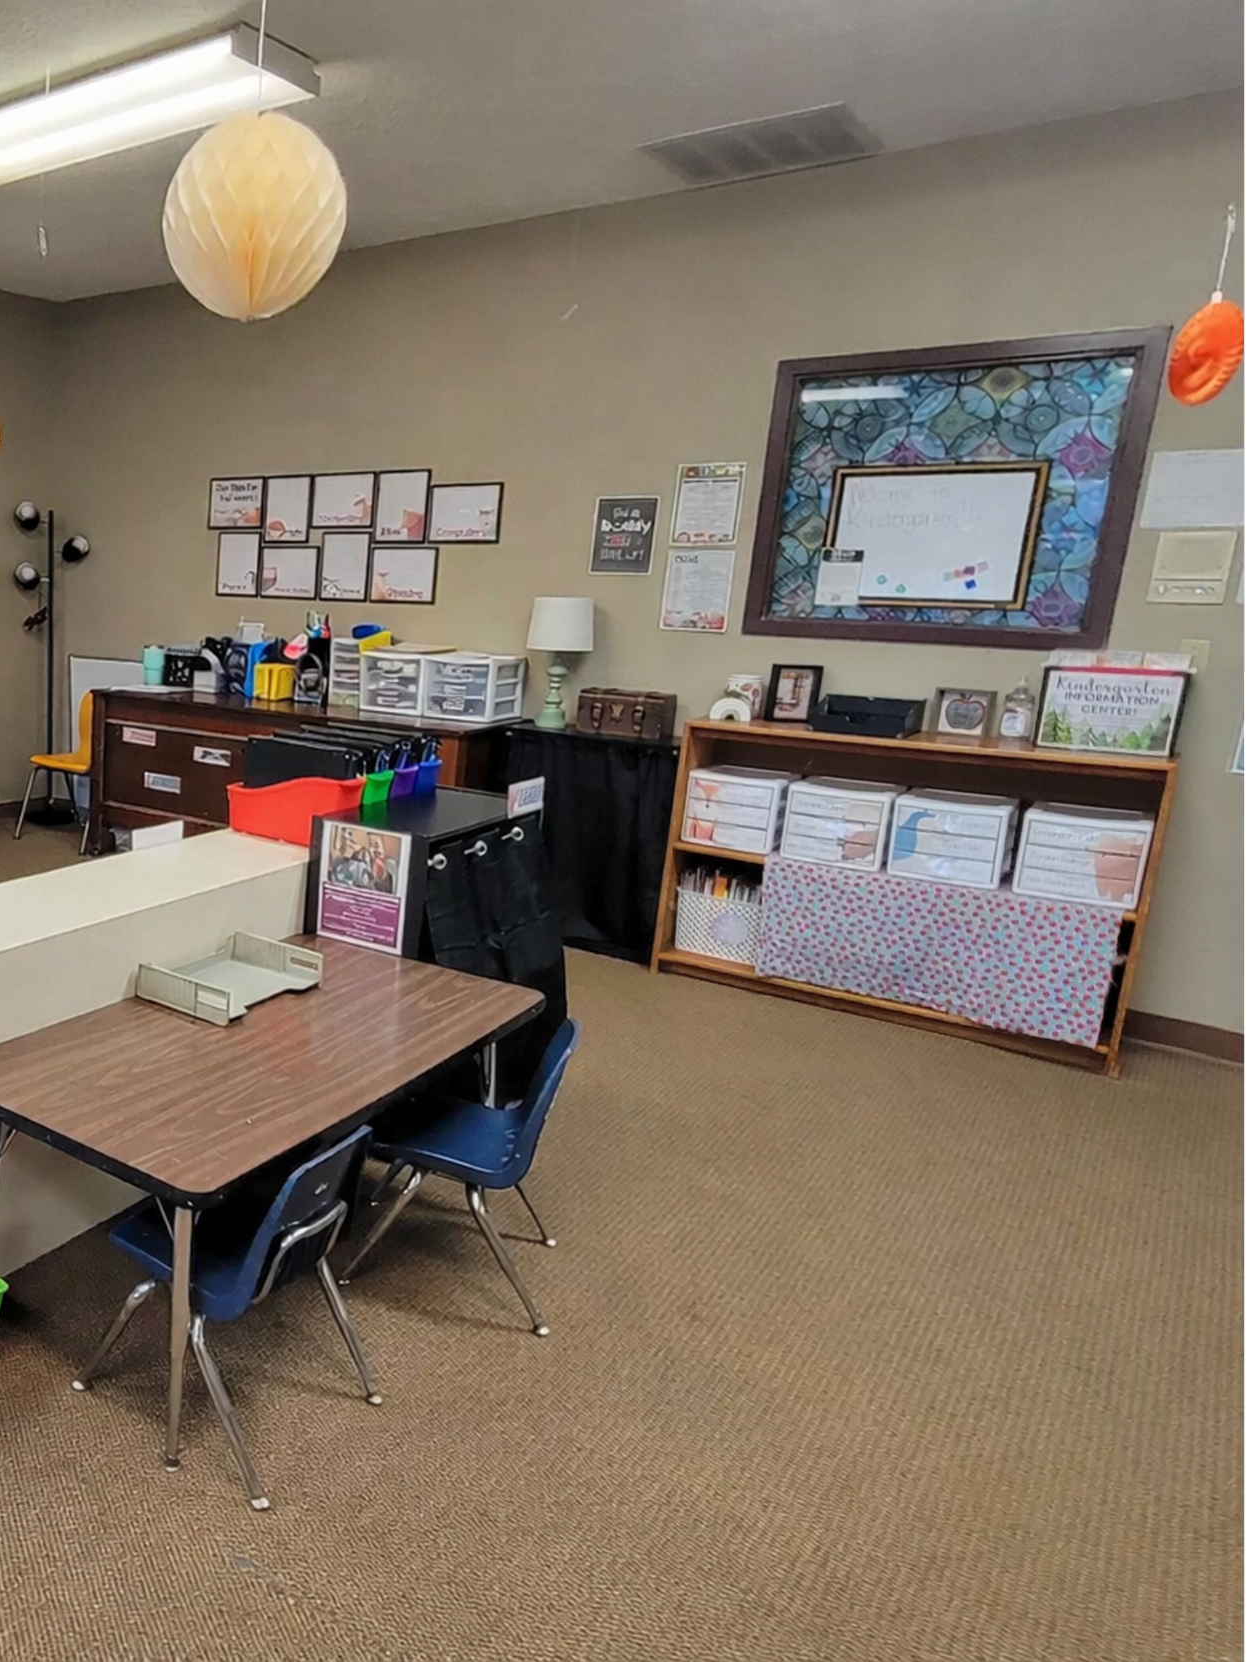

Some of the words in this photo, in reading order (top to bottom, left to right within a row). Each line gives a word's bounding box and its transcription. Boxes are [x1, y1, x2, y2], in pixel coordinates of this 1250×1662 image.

[1056, 675, 1173, 697] Kindergarten
[1064, 692, 1160, 706] INFORMATION
[1081, 704, 1138, 717] CENTER!
